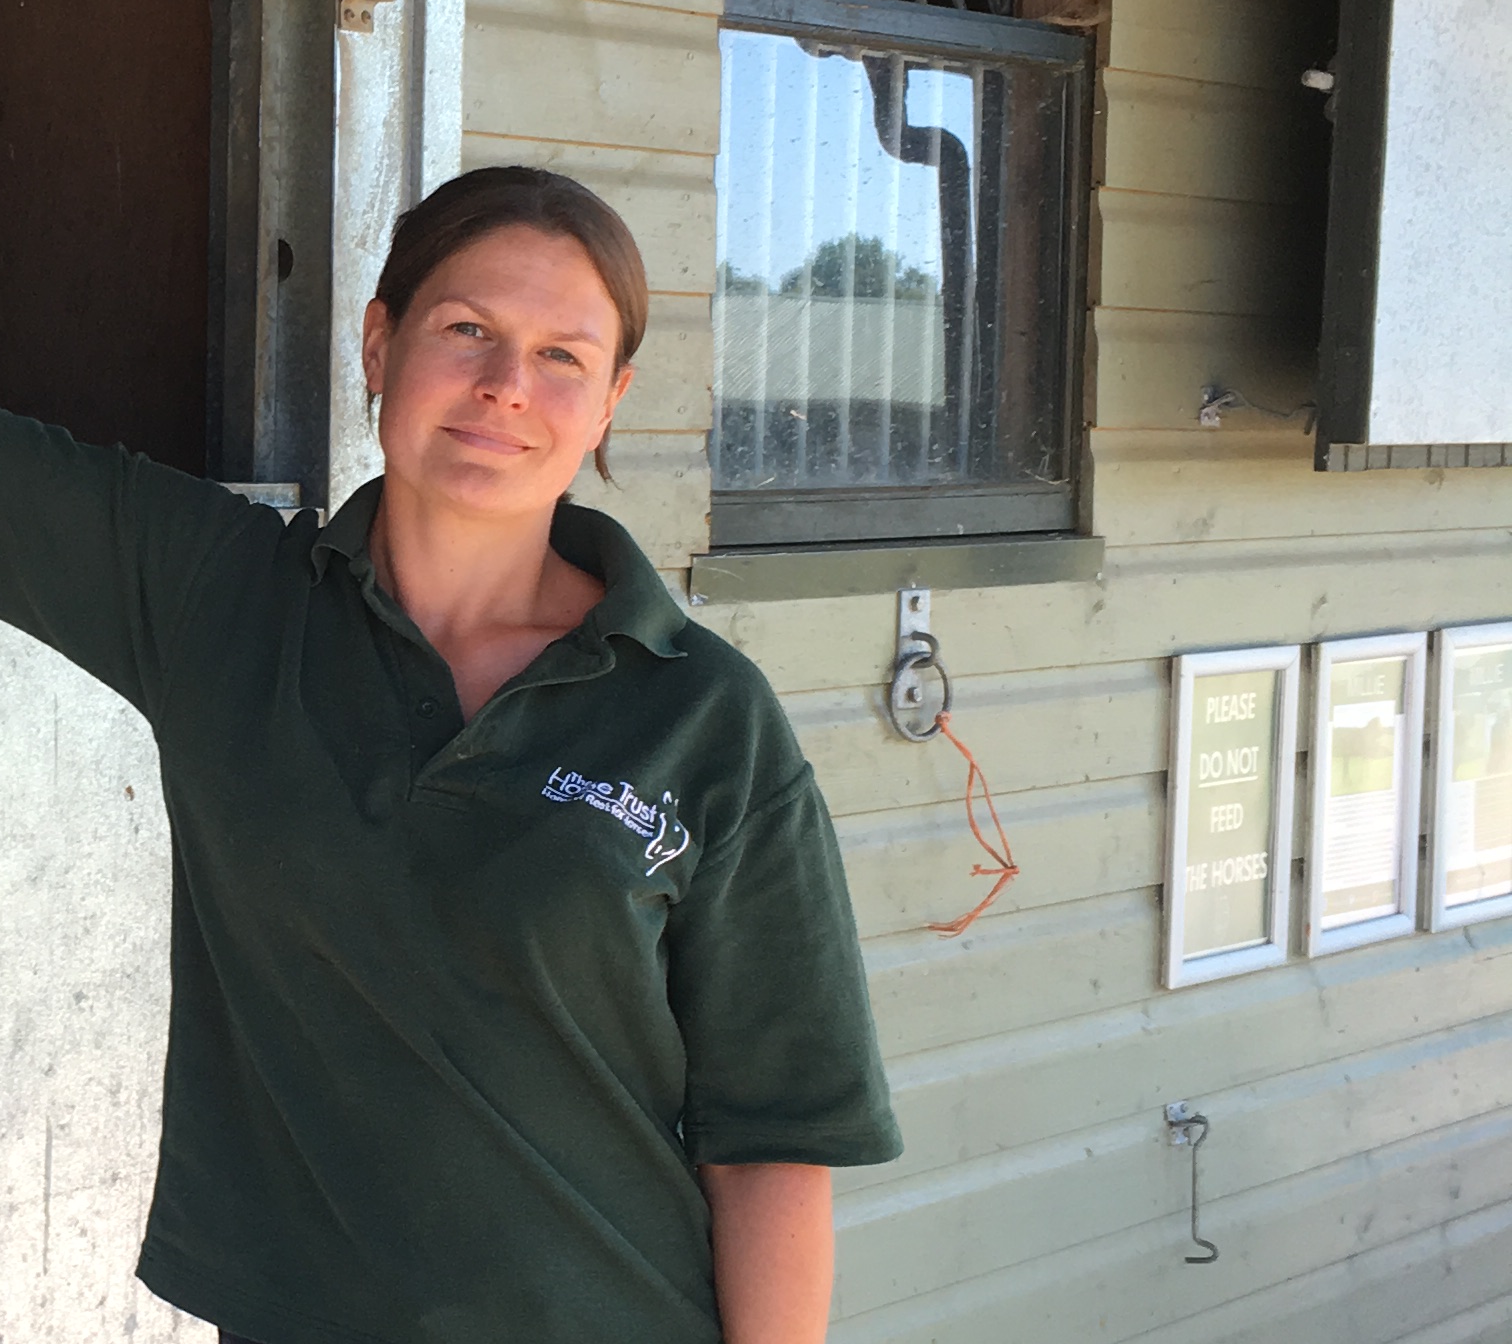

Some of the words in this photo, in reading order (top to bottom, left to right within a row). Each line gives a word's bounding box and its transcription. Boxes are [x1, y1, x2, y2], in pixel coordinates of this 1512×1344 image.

[1206, 692, 1256, 724] PLEASE
[1199, 752, 1223, 781] DO
[1226, 746, 1259, 777] NOT
[619, 781, 658, 823] Trust
[1210, 804, 1243, 833] FEED
[1186, 862, 1208, 893] THE
[1212, 852, 1268, 888] HORSES
